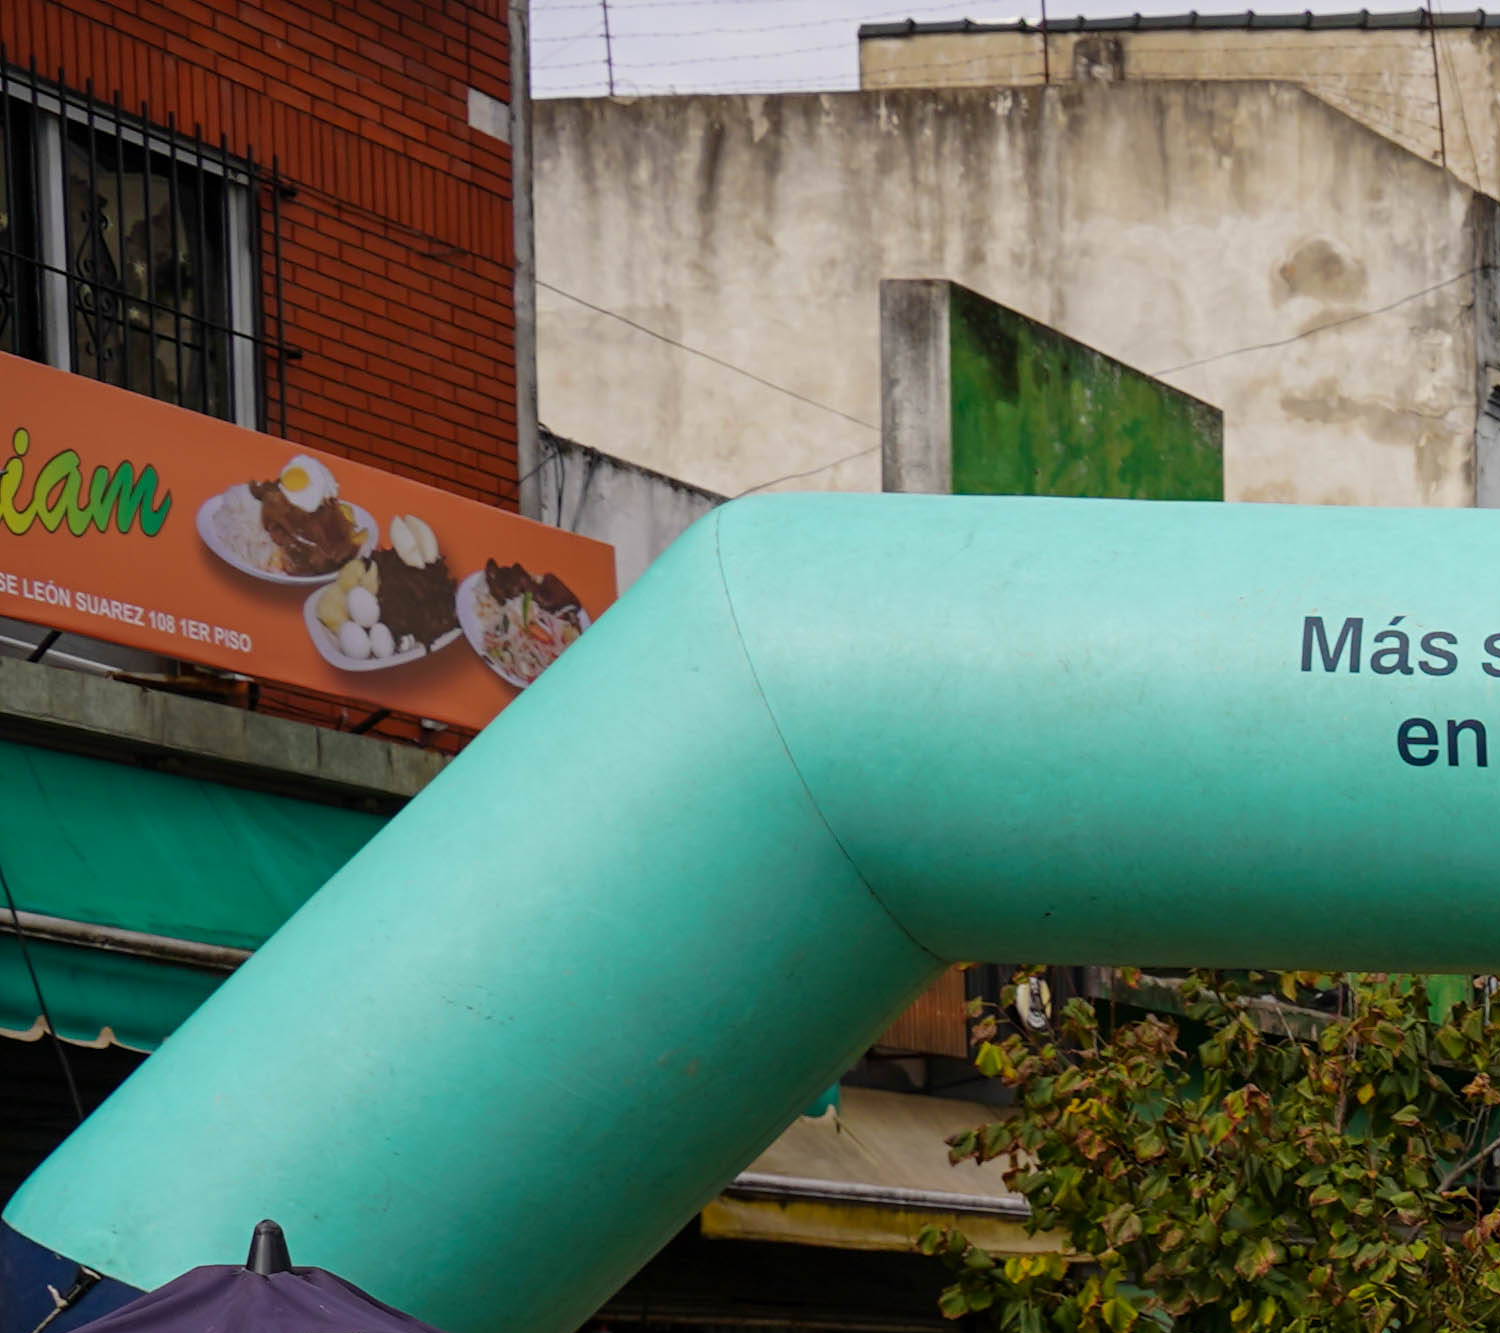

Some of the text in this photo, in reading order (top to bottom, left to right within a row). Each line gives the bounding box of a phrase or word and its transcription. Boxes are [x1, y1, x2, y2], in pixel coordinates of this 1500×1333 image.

[22, 577, 71, 608] LEÓN
[76, 592, 145, 627] SUAREZ
[149, 610, 176, 634] 108
[180, 618, 210, 643] 1ER
[214, 625, 252, 652] PISO
[1301, 616, 1458, 676] Más
[1396, 716, 1489, 767] en
